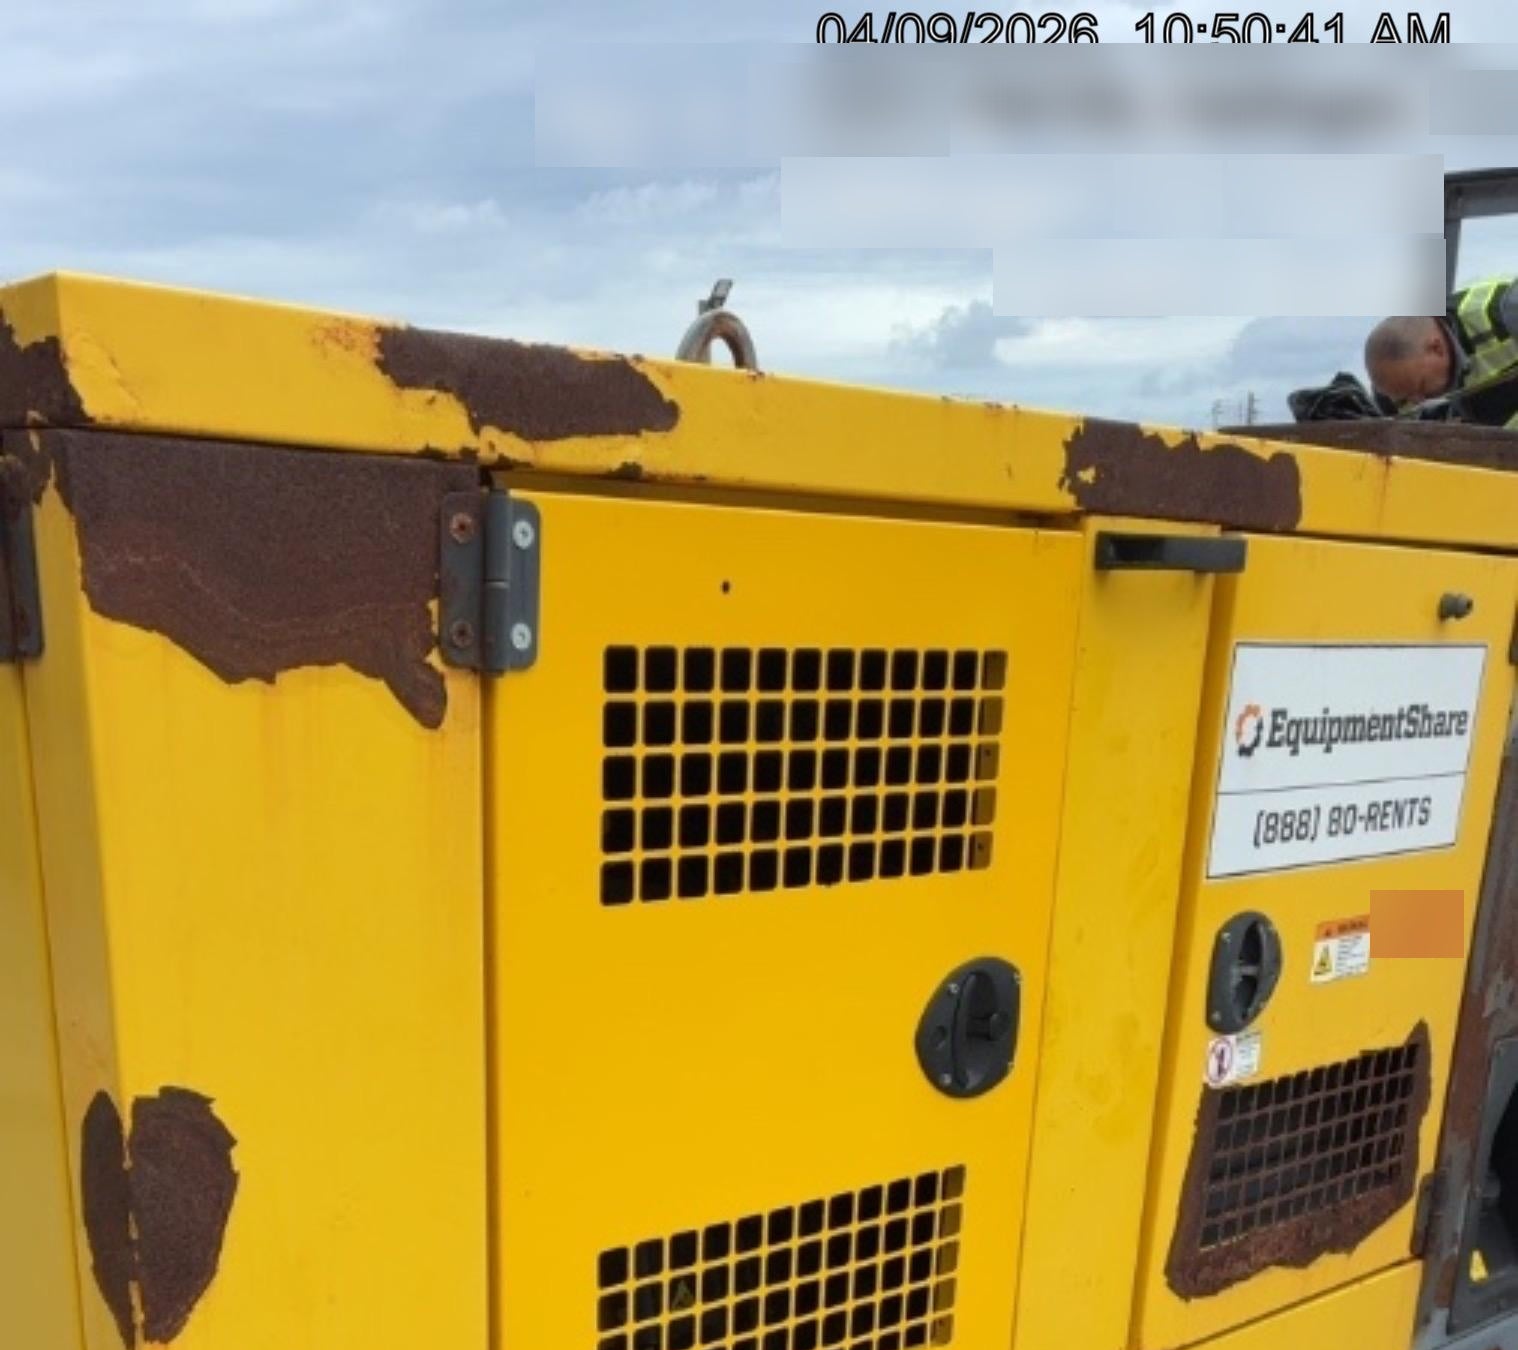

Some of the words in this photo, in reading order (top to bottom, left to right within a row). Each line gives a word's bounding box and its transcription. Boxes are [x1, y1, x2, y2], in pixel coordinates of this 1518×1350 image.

[1266, 704, 1468, 754] EquipmentShare
[1253, 806, 1321, 848] (888)
[1327, 797, 1432, 836] 80-RENTS
